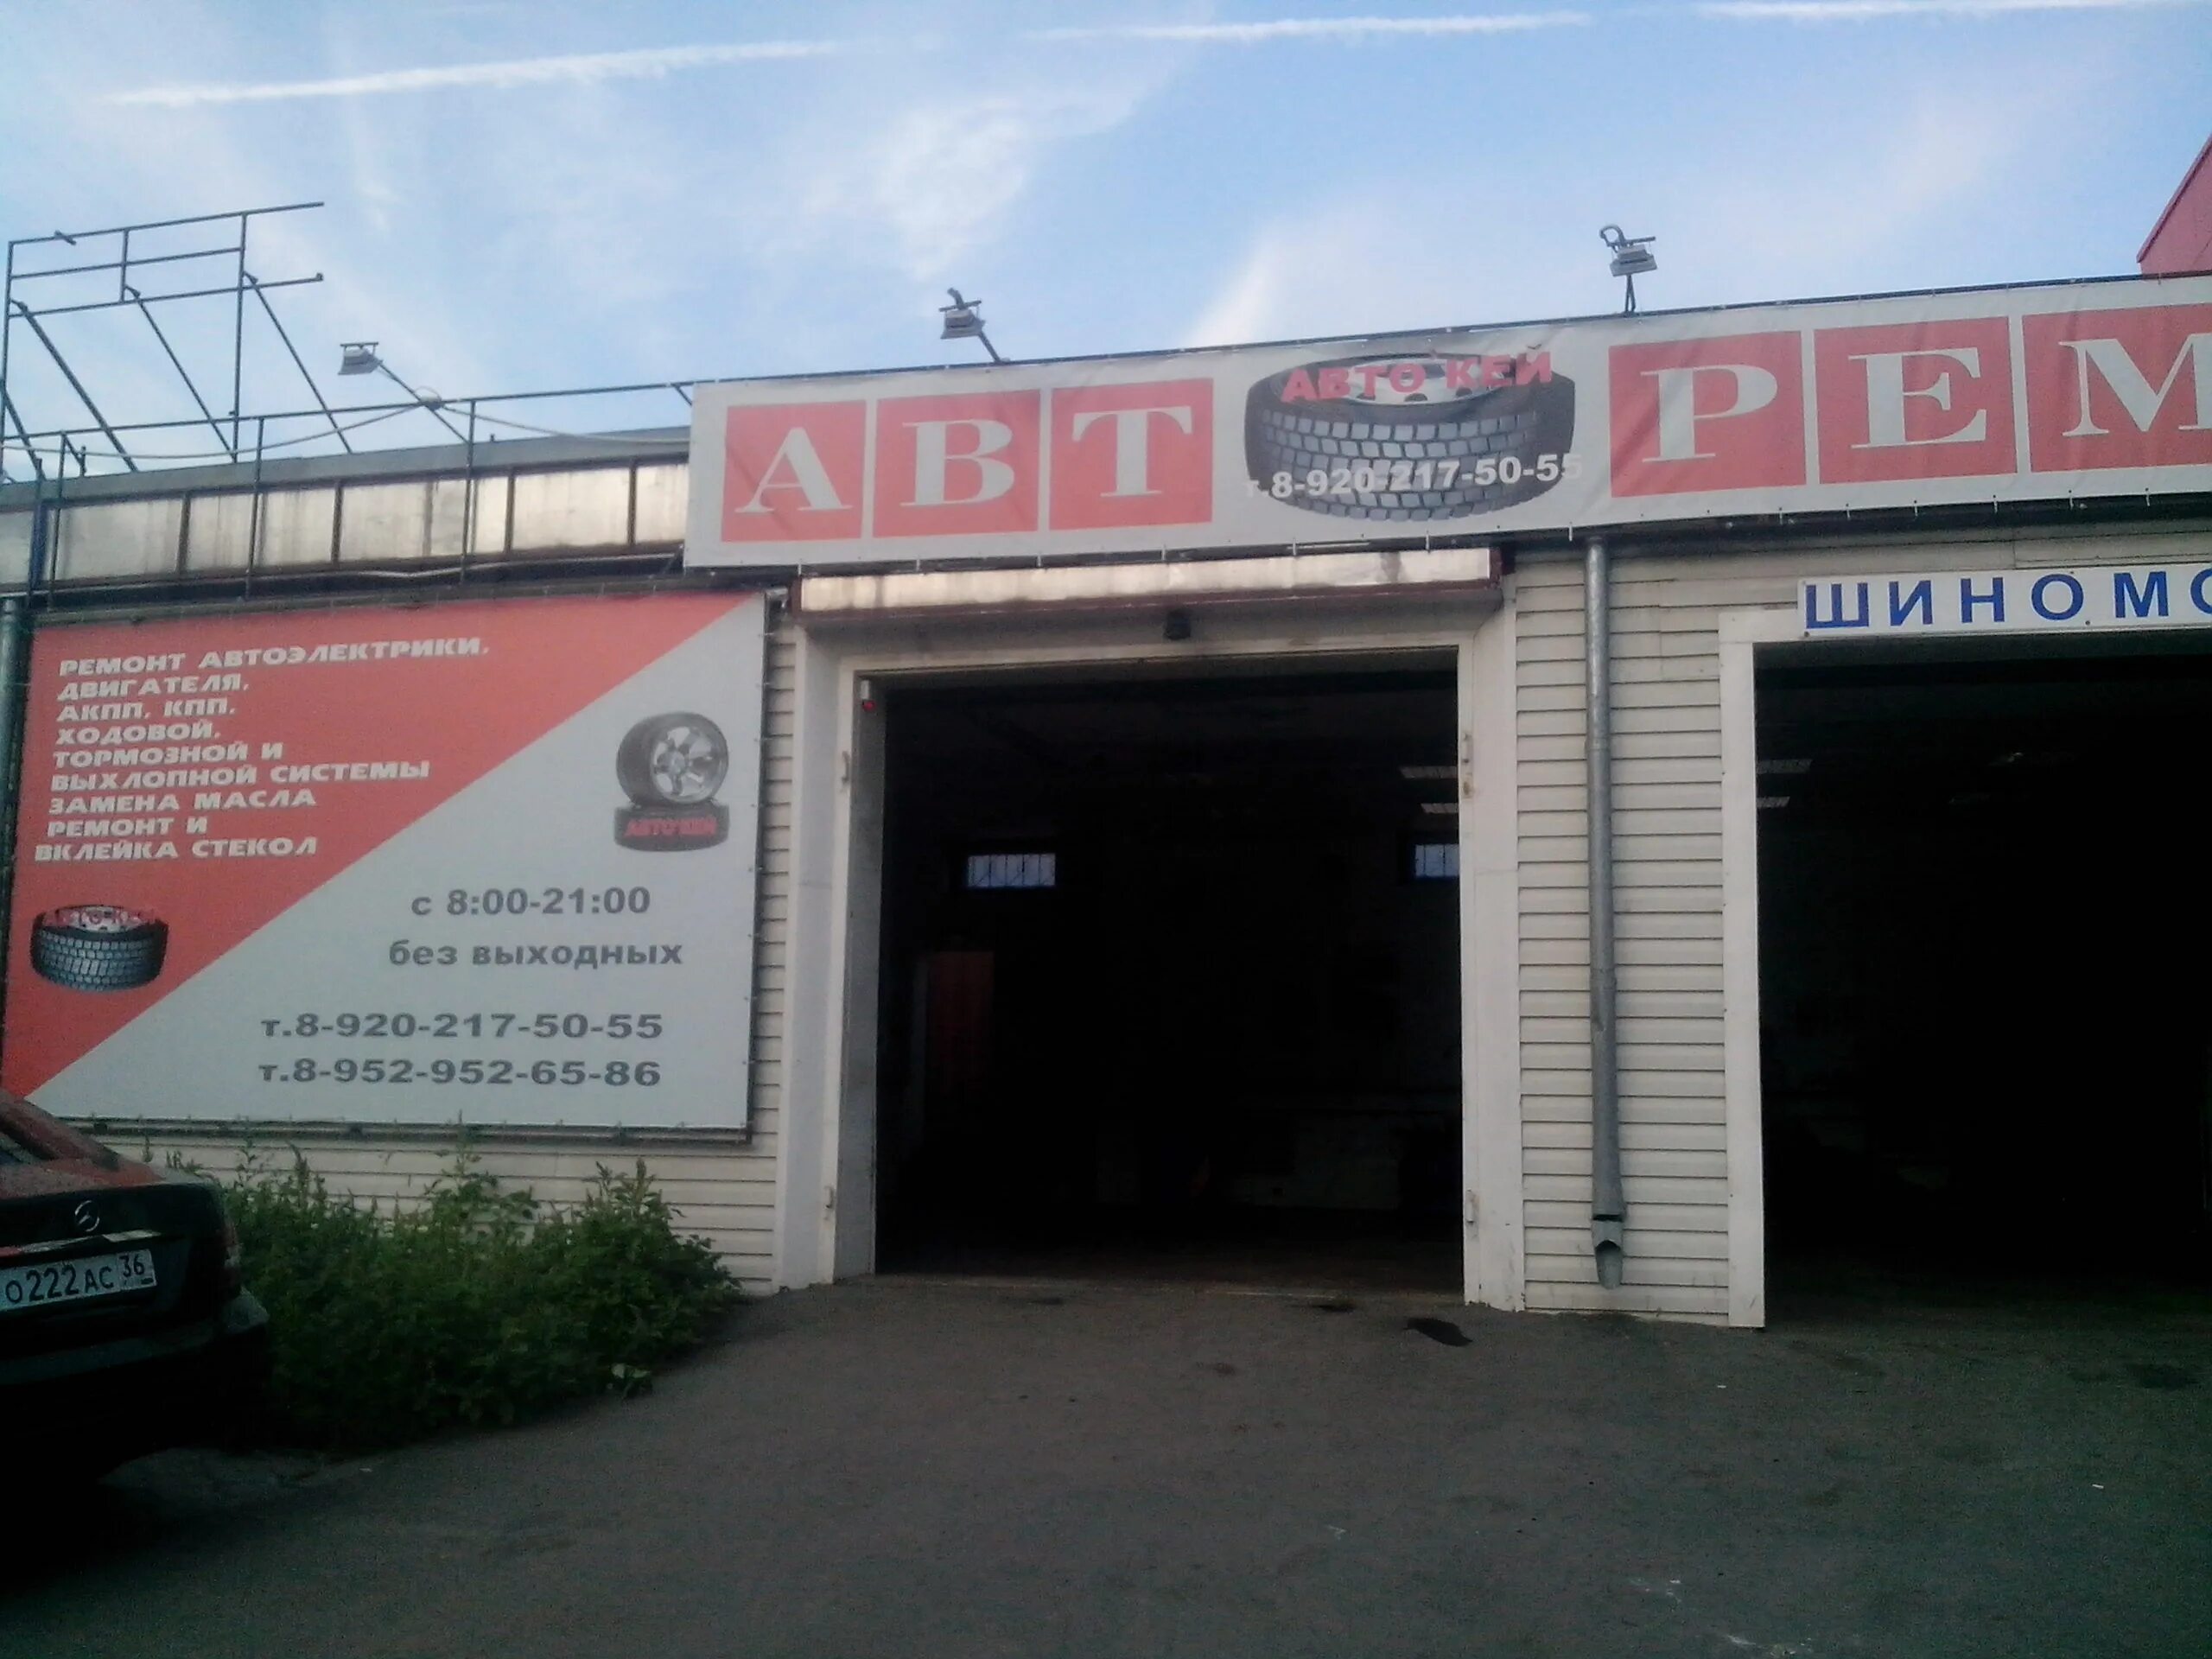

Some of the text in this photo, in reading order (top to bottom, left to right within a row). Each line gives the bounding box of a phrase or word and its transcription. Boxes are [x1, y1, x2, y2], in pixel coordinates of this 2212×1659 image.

[1281, 362, 1426, 403] АВТО
[60, 653, 185, 677] РЕМОНТ
[54, 741, 283, 769] ТОРМОЗНОЙ И
[51, 760, 429, 791] ВЫХЛОПНОЙ СИСТЕМЫ
[48, 789, 316, 815] ЗАМЕНА МАСЛА
[48, 817, 207, 837] РЕМОНТ И
[35, 836, 317, 862] ВКЛЕЙКА СТЕКОЛ
[410, 887, 652, 916] с 8:00-21:00
[389, 939, 683, 970] без выходных
[261, 1012, 664, 1039] т.8-920-217-50-55
[258, 1058, 662, 1087] т.8-952-952-65-86
